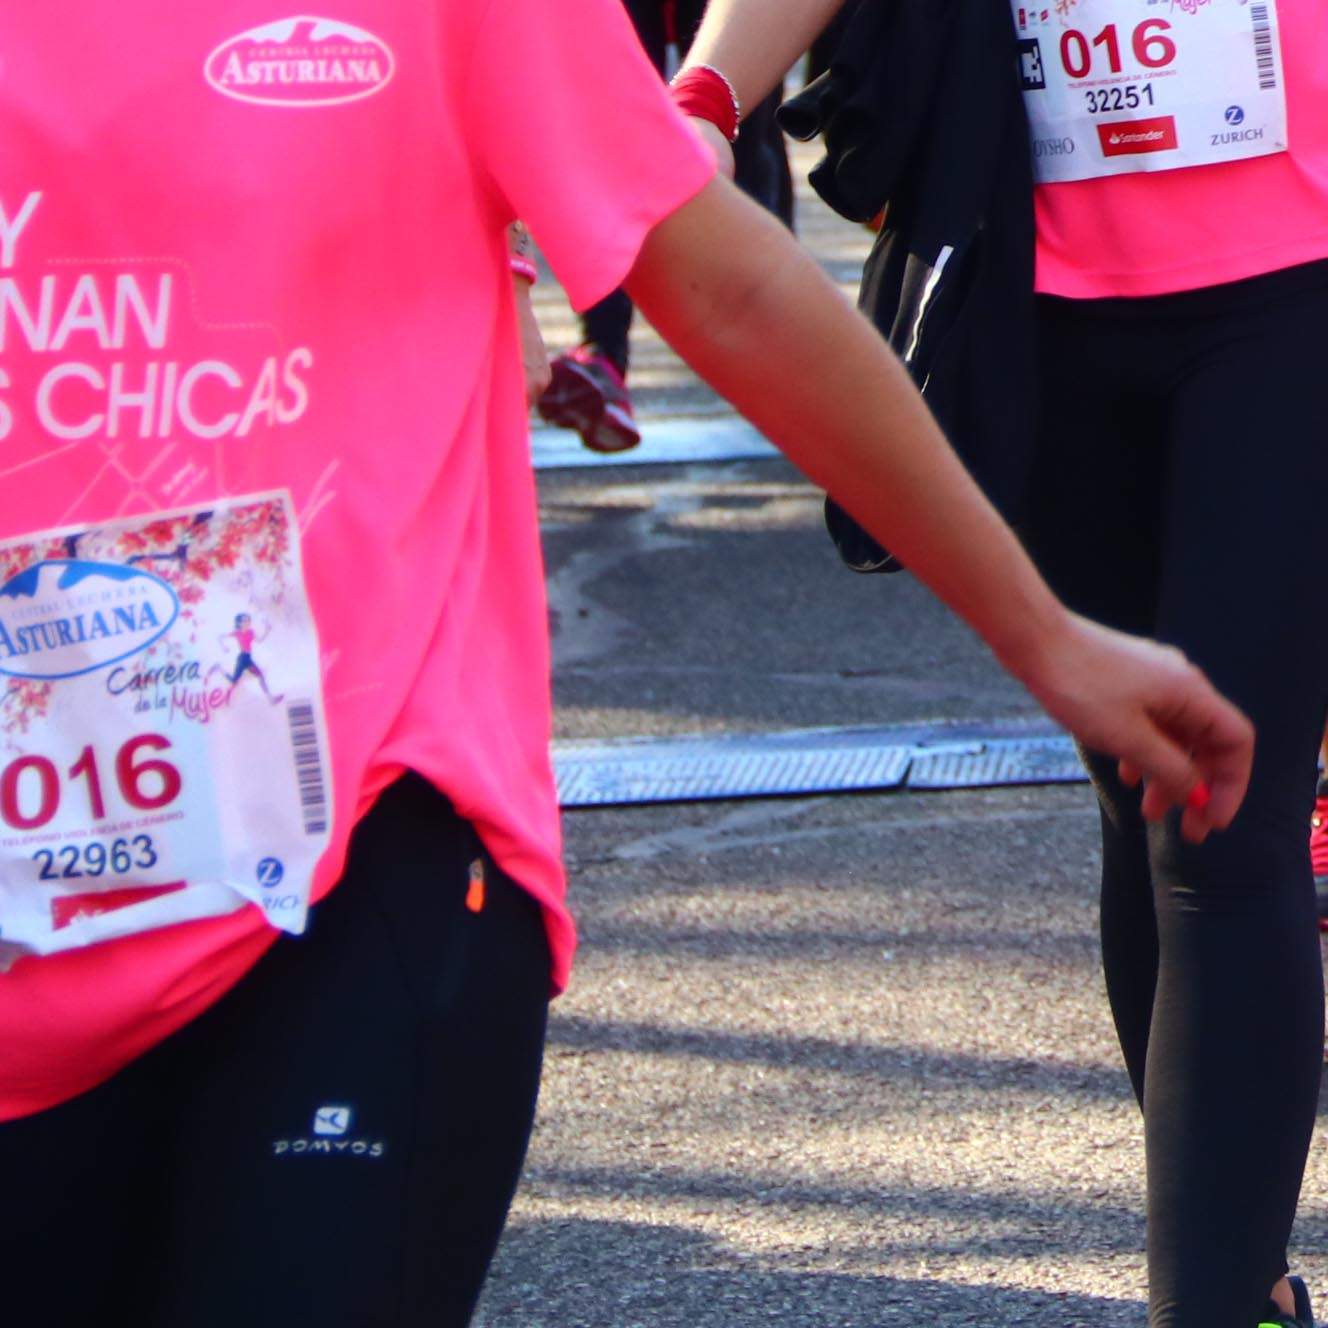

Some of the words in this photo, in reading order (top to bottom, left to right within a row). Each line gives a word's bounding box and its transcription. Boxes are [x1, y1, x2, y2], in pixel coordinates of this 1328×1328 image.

[220, 50, 382, 85] ASTURIANA
[1060, 18, 1176, 79] 016
[1085, 82, 1154, 114] 32251
[1120, 129, 1164, 143] Santander
[1211, 129, 1264, 147] ZURICH
[36, 347, 313, 440] CHICAS
[0, 600, 162, 659] ASTURIANA
[106, 659, 201, 696] Carrera
[135, 696, 150, 714] de
[153, 691, 167, 711] la
[168, 682, 236, 725] Mujer
[0, 733, 183, 830] 016
[32, 834, 158, 880] 22963
[273, 1139, 383, 1157] DOMYOS
